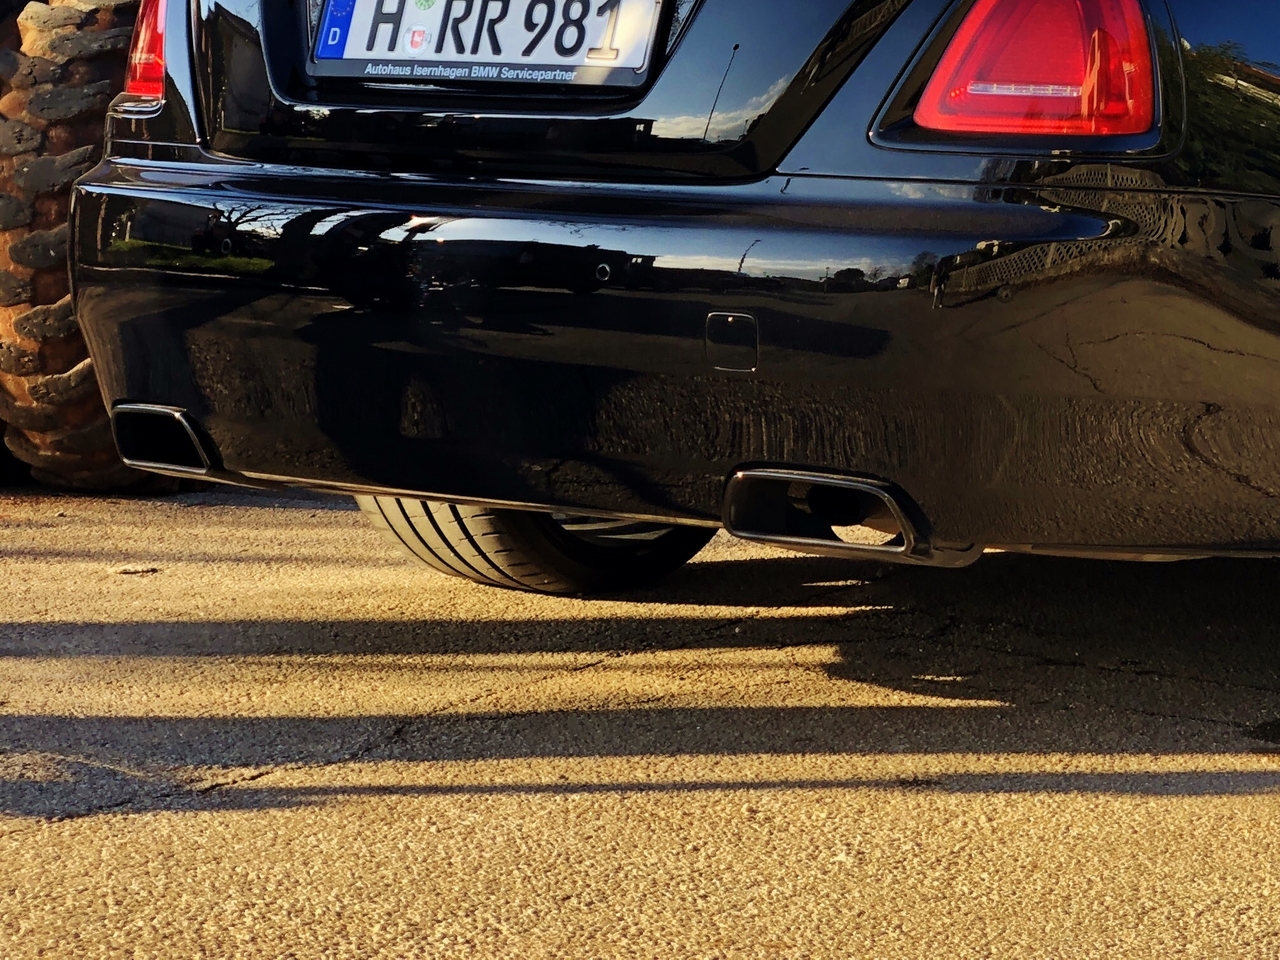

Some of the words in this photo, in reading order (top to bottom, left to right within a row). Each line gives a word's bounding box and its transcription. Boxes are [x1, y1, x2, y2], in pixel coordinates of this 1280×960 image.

[364, 63, 411, 75] Autohaus
[413, 65, 469, 79] Isernhagen
[471, 67, 499, 78] BMW
[500, 68, 577, 81] Servicepartner
